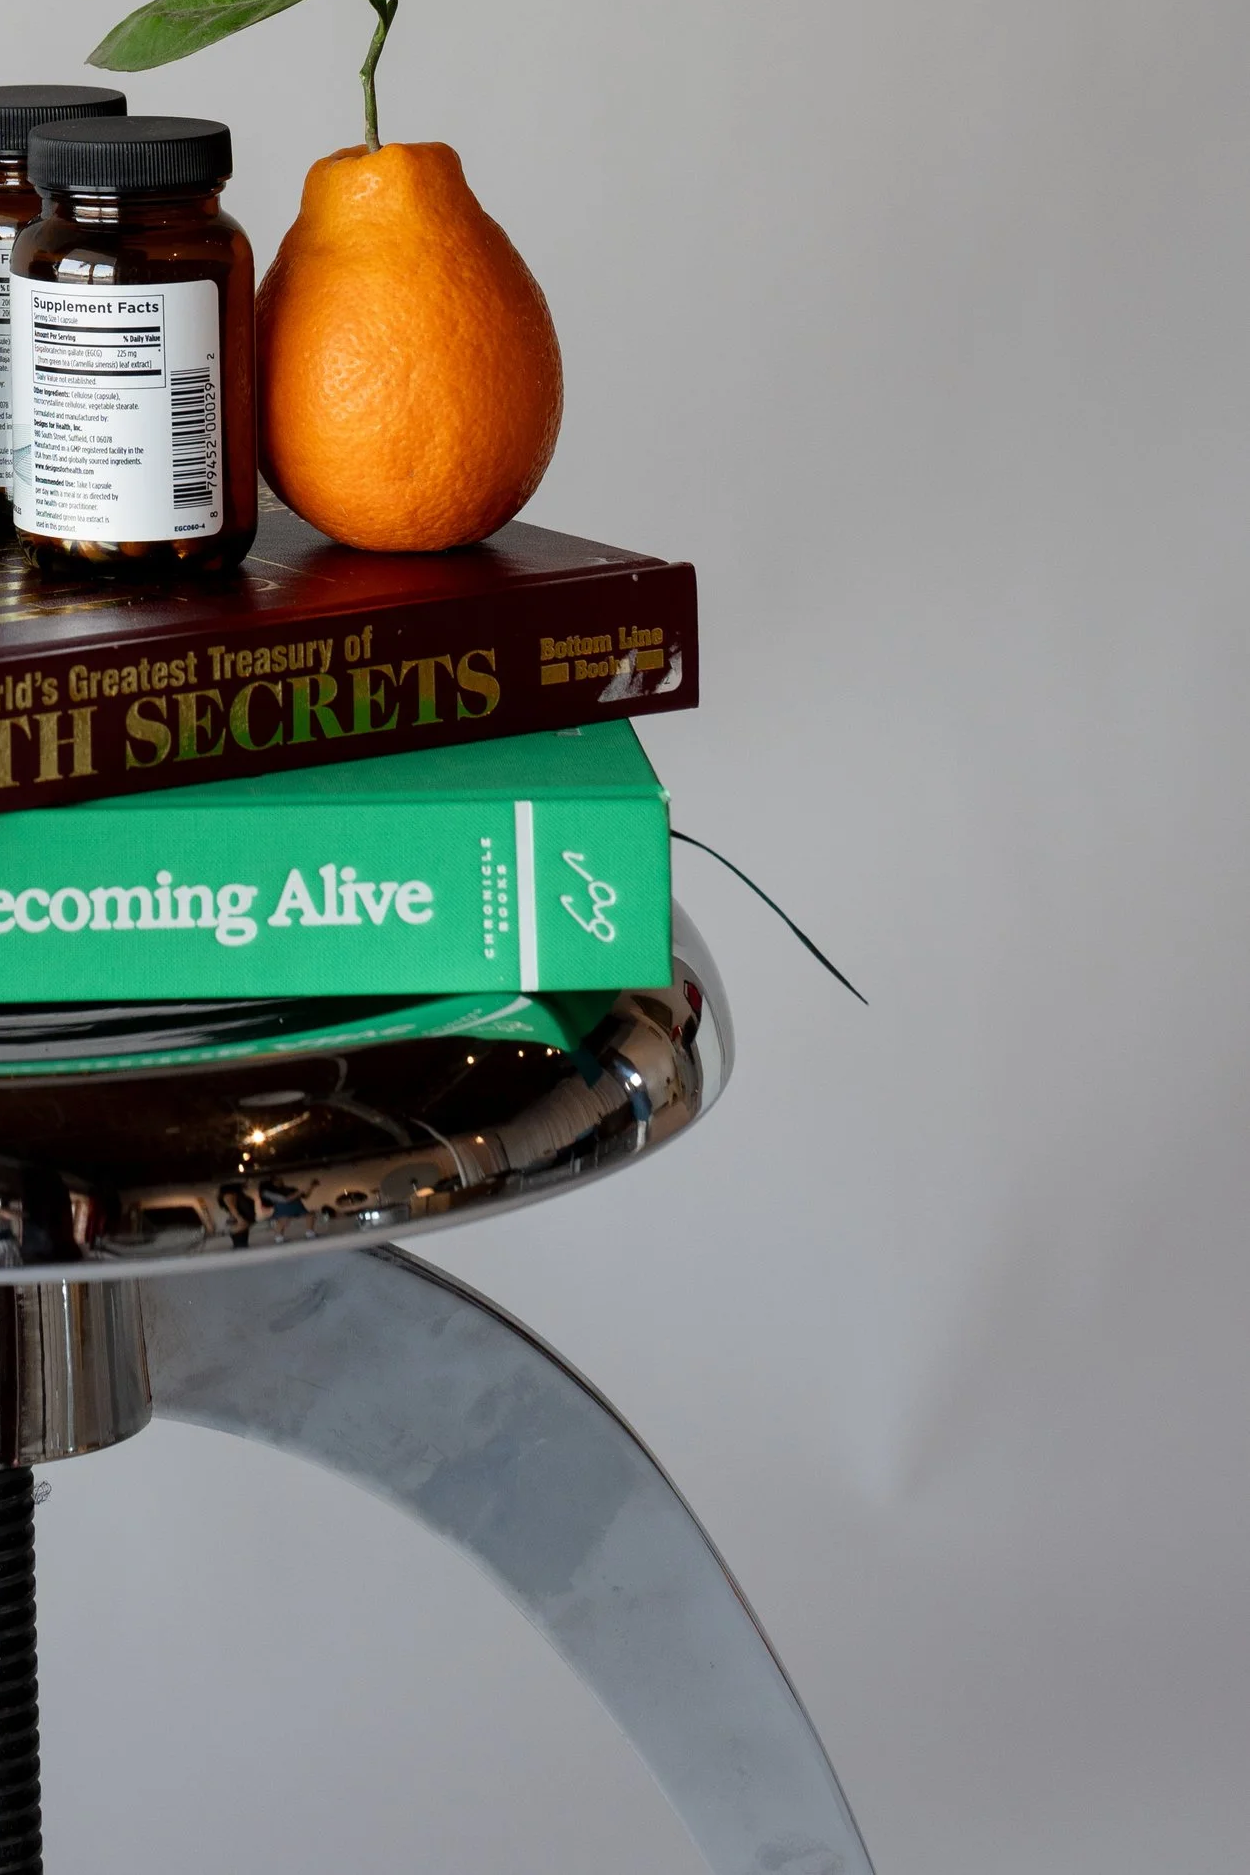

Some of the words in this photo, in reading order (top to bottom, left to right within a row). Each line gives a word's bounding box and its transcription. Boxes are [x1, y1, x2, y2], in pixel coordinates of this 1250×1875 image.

[34, 297, 113, 313] Supplement
[118, 302, 159, 313] Facts
[34, 330, 49, 339] Amount
[58, 333, 76, 342] Serving
[130, 335, 144, 343] Daily
[145, 334, 161, 342] Value
[205, 382, 216, 432] 00029
[206, 440, 218, 489] 79452
[90, 492, 110, 500] directed
[111, 493, 119, 501] by
[210, 510, 219, 518] 8
[68, 651, 197, 702] Greatest
[208, 637, 334, 681] Treasury
[344, 625, 373, 662] of
[540, 633, 613, 662] Bottom
[618, 625, 664, 650] Line
[125, 647, 502, 770] SECRETS
[268, 863, 435, 927] Alive
[480, 837, 495, 960] CHRONICLE
[496, 864, 509, 933] BOOKS
